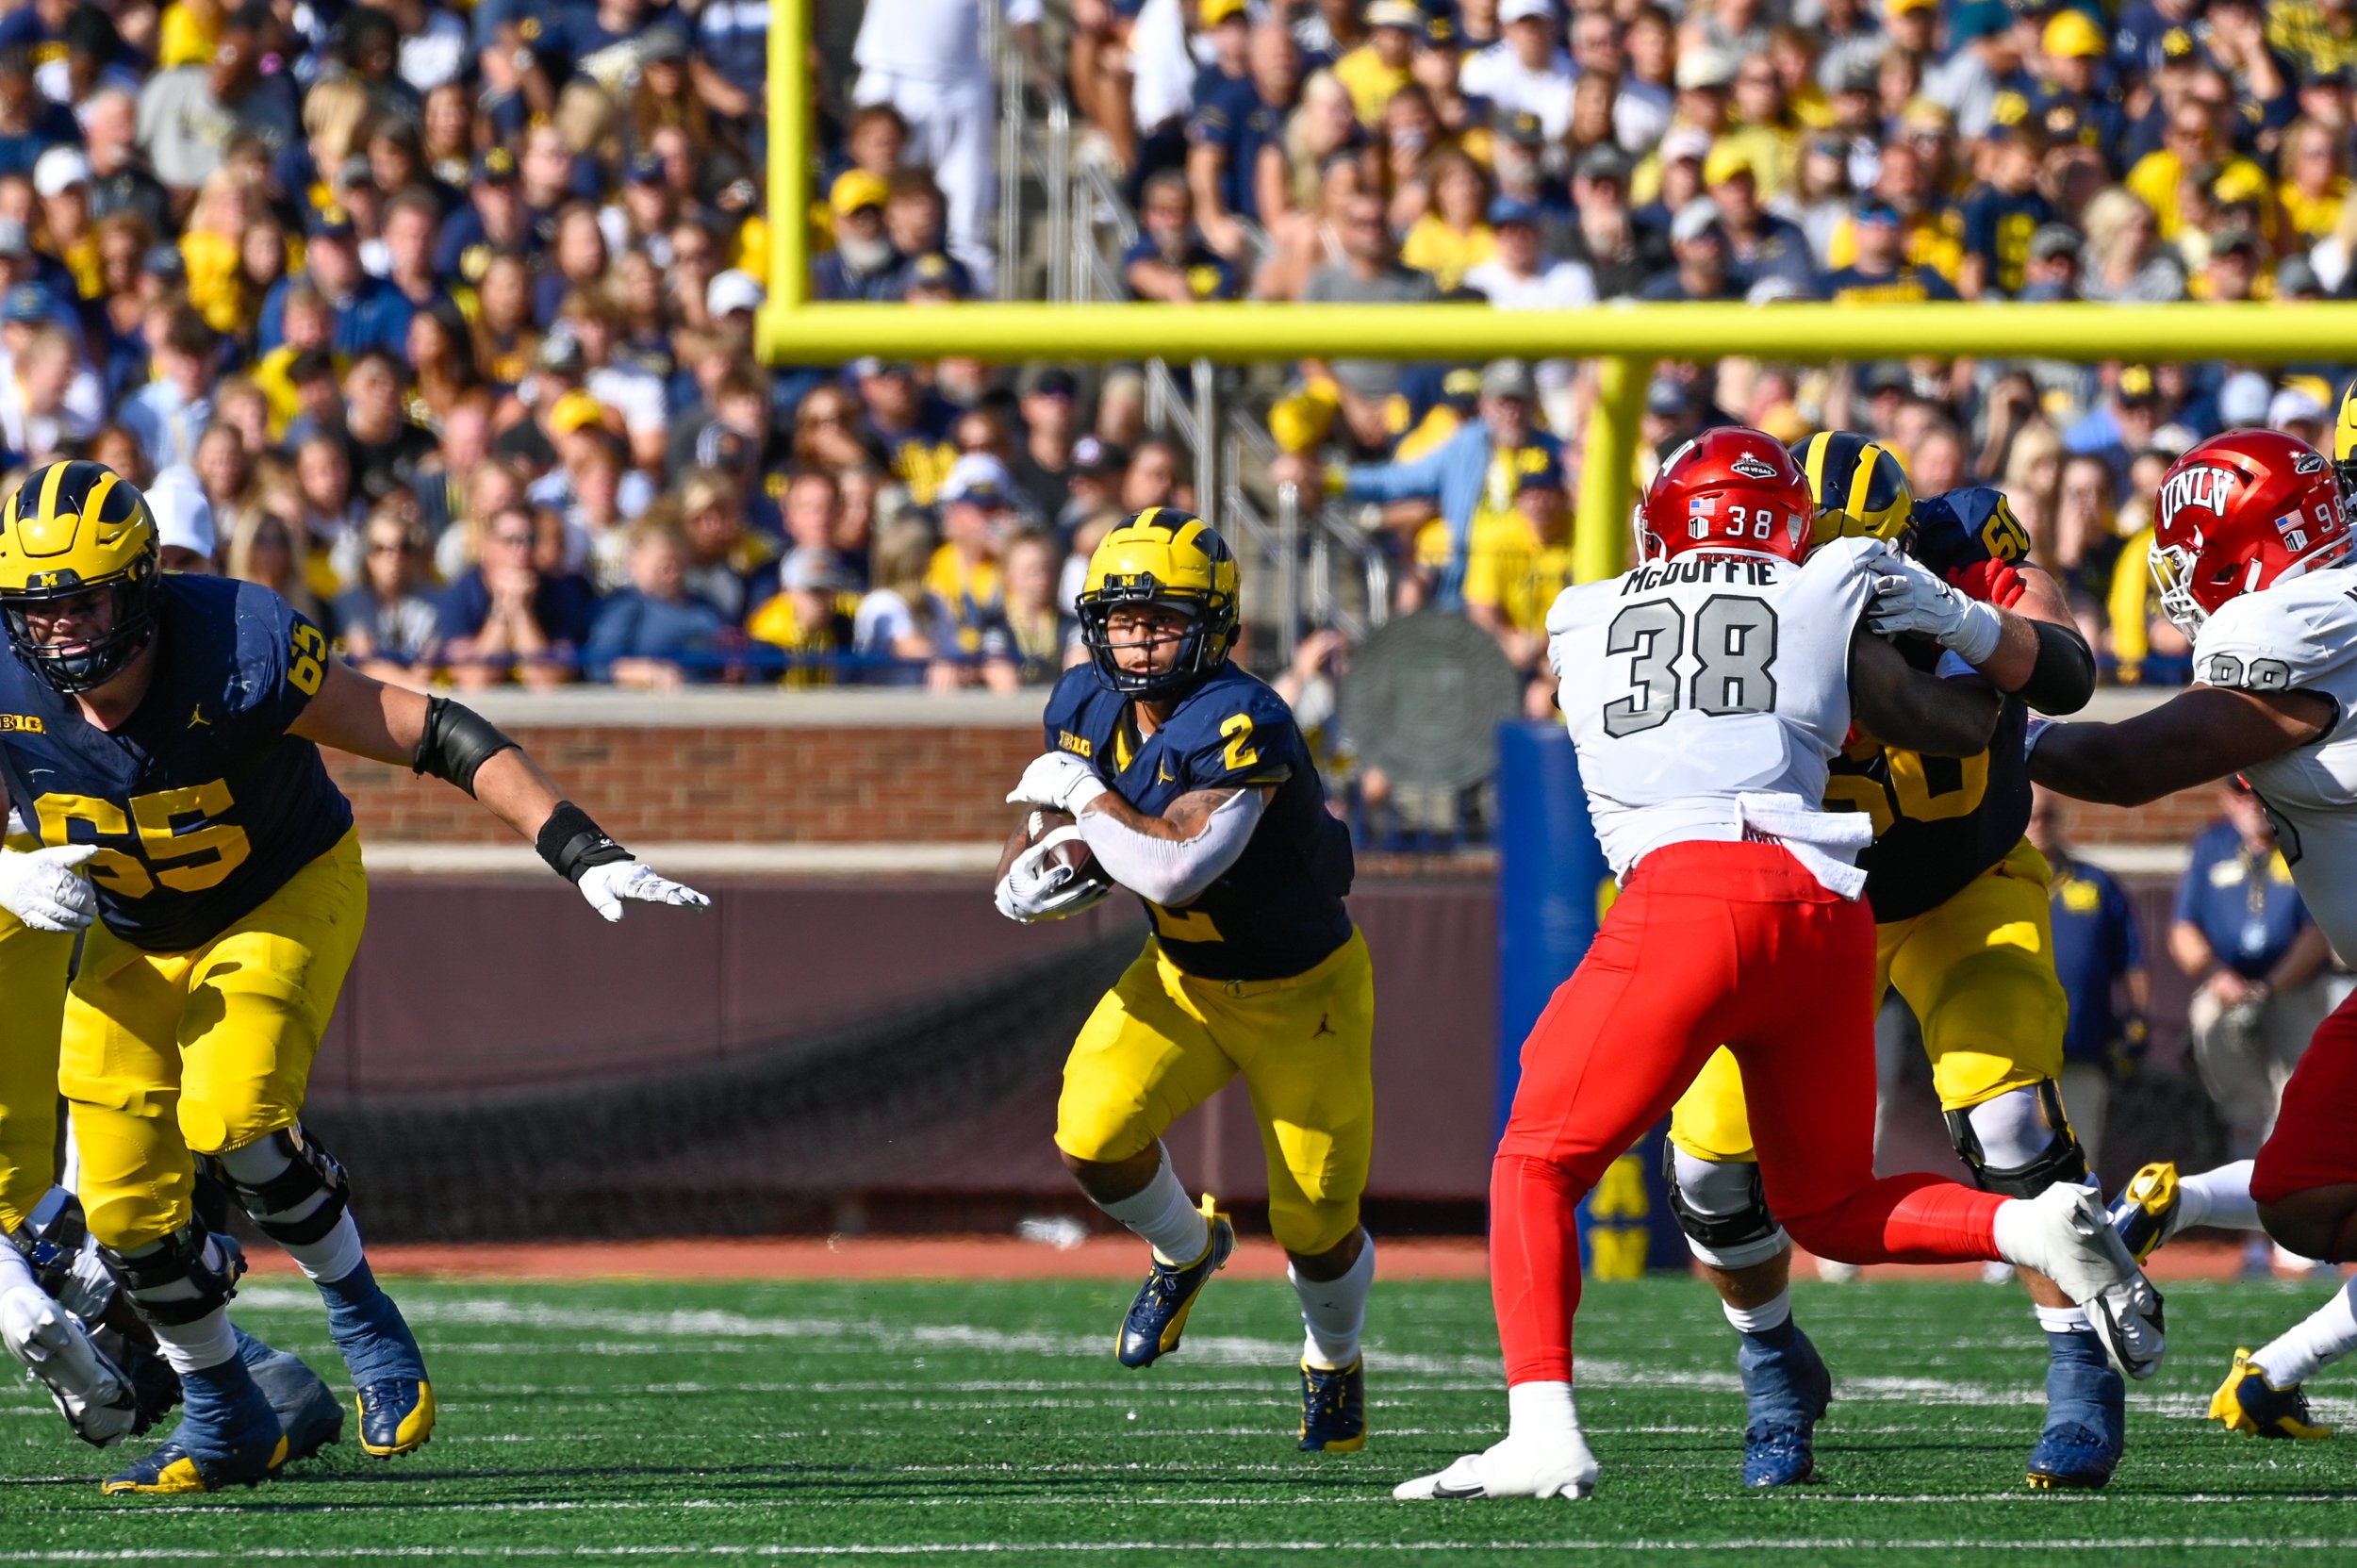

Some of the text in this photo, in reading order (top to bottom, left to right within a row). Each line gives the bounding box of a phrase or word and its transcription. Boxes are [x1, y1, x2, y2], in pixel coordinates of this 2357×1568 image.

[1750, 467, 1772, 475] VEGAS
[1725, 505, 1772, 539] 38
[2160, 466, 2235, 530] UNLV
[2315, 494, 2347, 534] 98
[1982, 495, 2029, 562] 60
[41, 573, 58, 586] M
[1122, 575, 1134, 586] M
[1621, 561, 1778, 596] McDUFFIE
[288, 620, 326, 695] 65
[1603, 593, 1778, 739] 38
[1220, 713, 1258, 770] 2
[33, 777, 251, 900] 65
